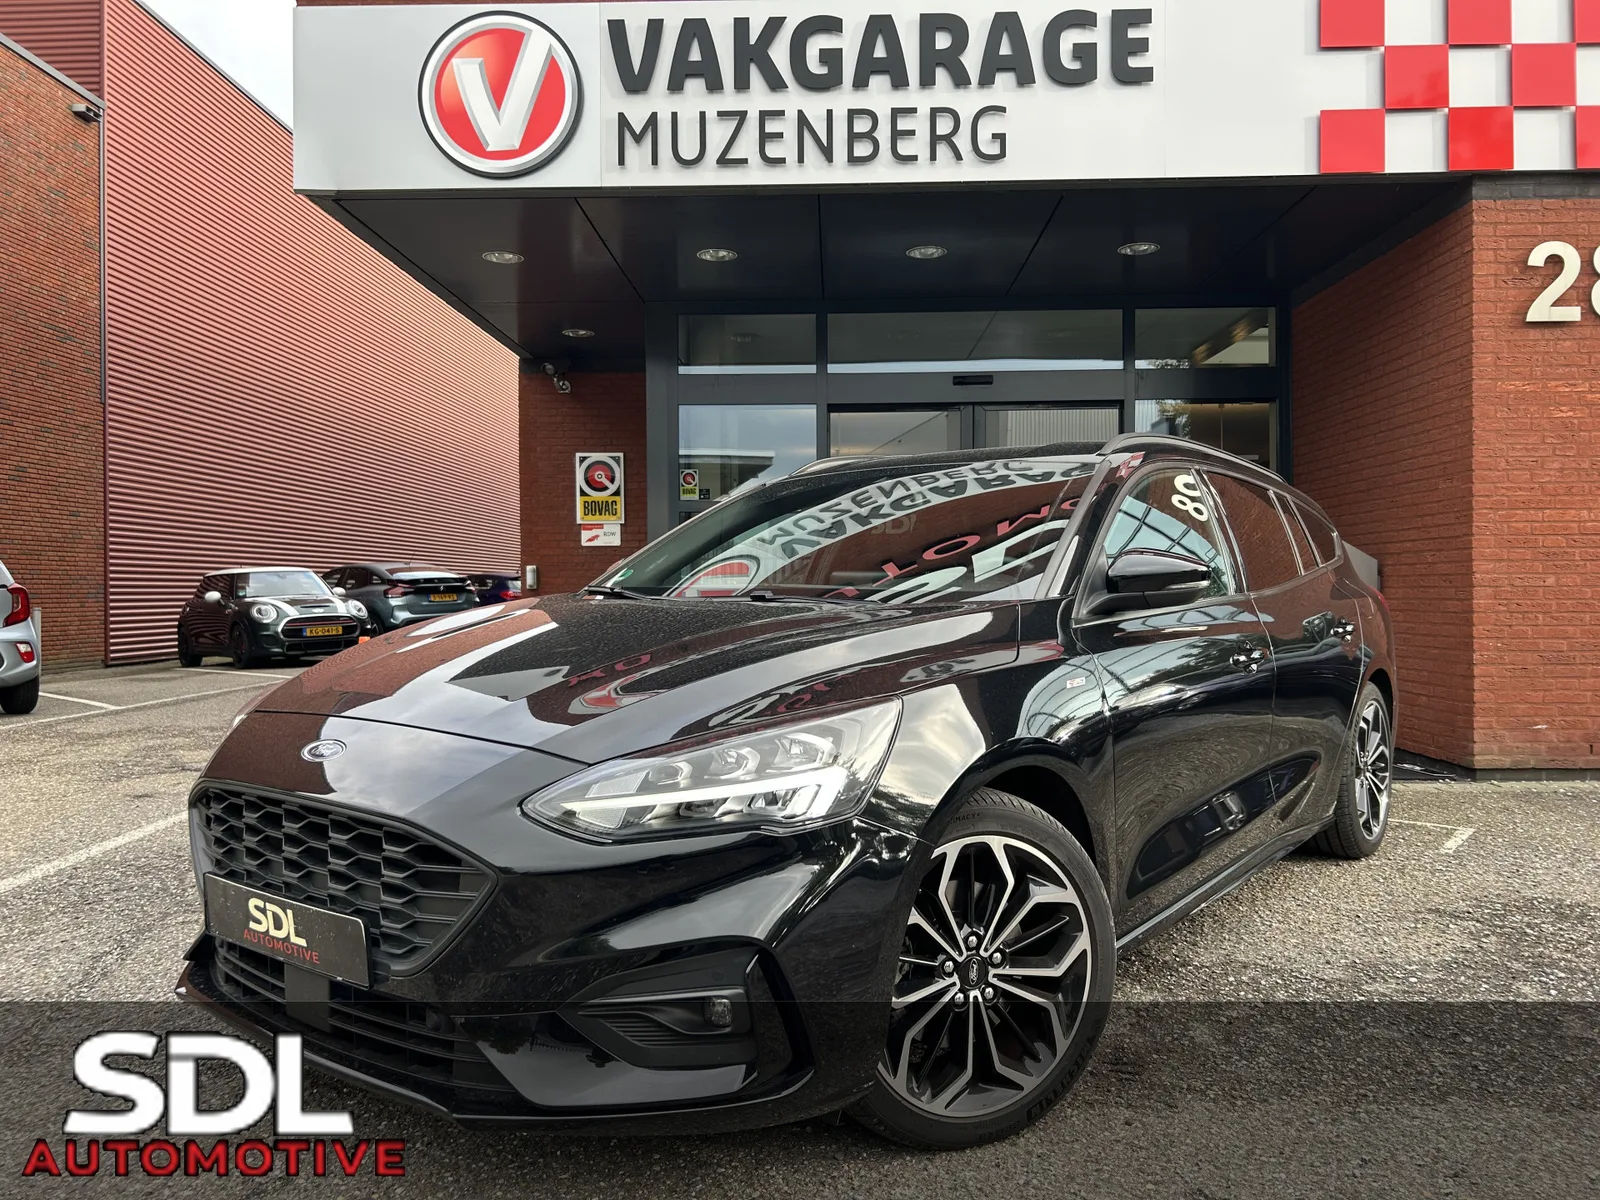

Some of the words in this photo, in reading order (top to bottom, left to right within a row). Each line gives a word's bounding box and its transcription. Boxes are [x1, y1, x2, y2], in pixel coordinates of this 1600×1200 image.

[607, 8, 1154, 92] VAKGARAGE
[617, 105, 1007, 167] MUZENBERG
[1525, 240, 1600, 322] 2
[583, 500, 618, 516] BOVAG
[243, 928, 320, 964] AUTOMOTIVE
[247, 897, 308, 948] SDL
